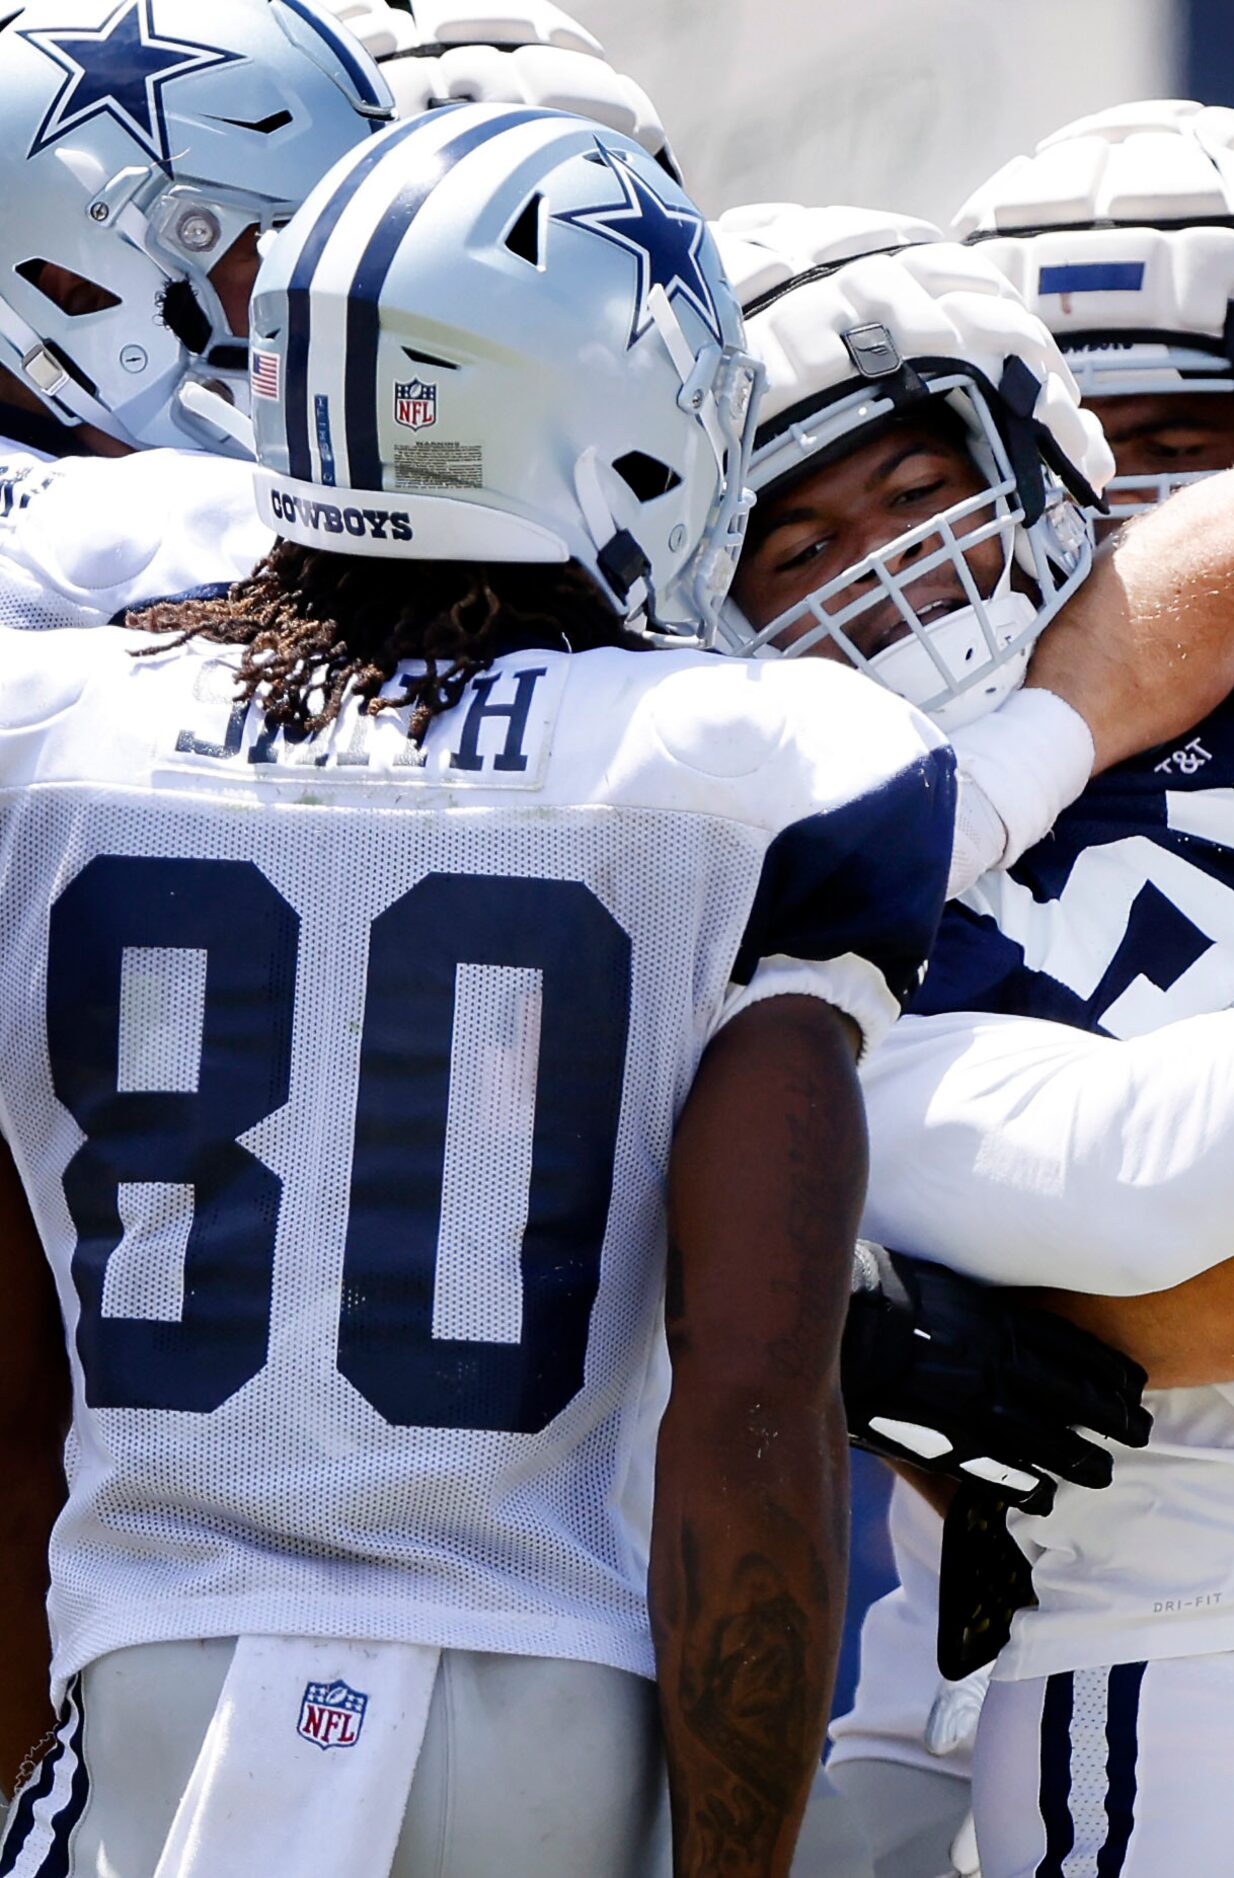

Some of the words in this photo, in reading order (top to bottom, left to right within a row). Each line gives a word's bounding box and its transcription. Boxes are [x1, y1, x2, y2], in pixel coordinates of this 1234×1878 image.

[399, 401, 432, 425] NFL
[271, 489, 413, 541] COWBOYS
[46, 853, 633, 1434] 80
[1153, 1592, 1223, 1613] DRI-FIT
[302, 1704, 354, 1743] NFL
